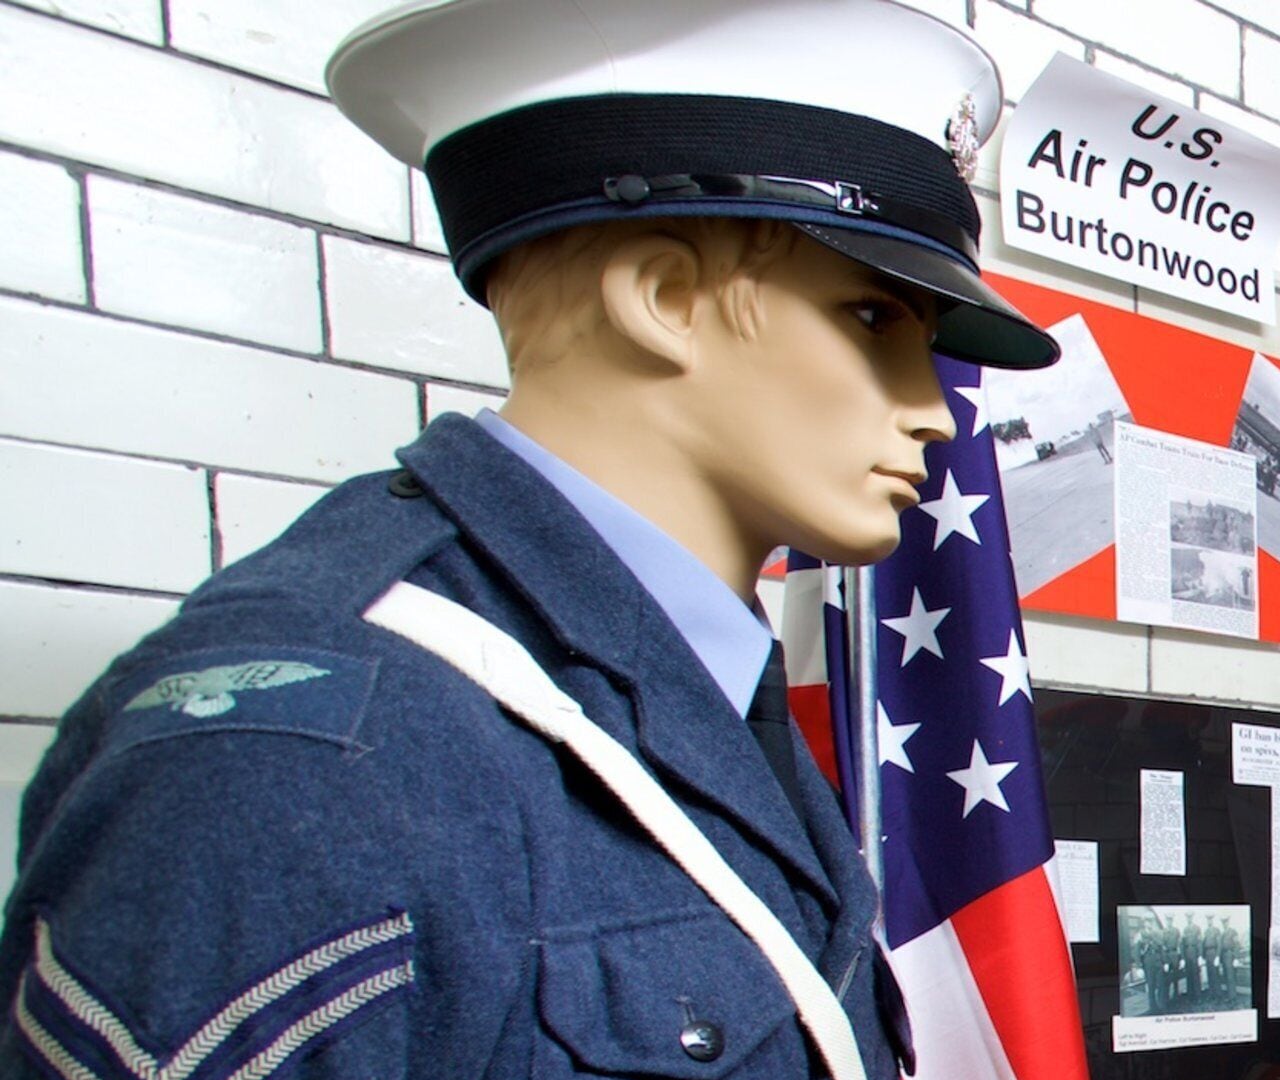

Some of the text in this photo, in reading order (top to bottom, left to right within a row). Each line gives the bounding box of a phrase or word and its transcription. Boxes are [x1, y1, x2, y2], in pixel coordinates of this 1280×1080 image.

[1027, 129, 1254, 241] Air Police
[1131, 104, 1222, 167] U.S.
[1017, 189, 1260, 303] Burtonwood
